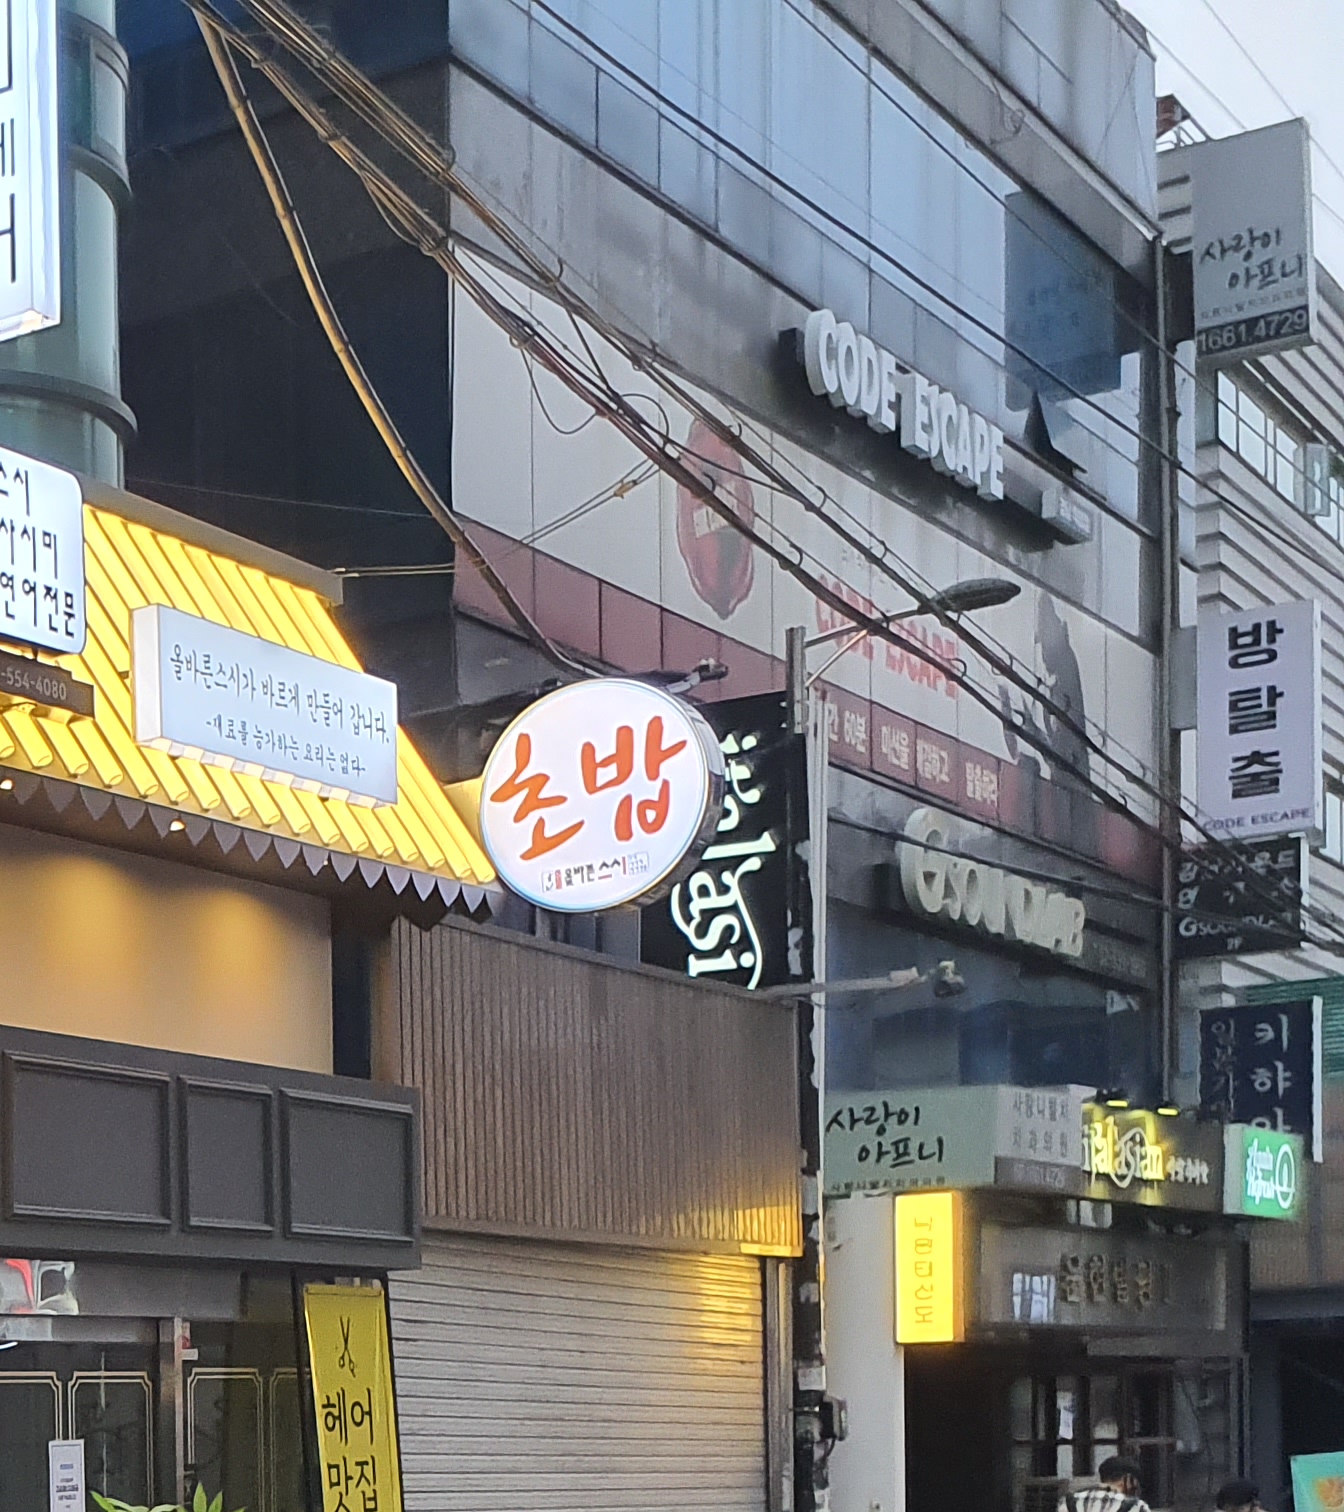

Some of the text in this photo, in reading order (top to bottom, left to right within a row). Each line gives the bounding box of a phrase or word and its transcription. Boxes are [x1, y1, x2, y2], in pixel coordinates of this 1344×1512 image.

[1199, 226, 1281, 265] 사랑이
[1227, 254, 1304, 291] 아프니
[805, 309, 1004, 500] CODE ESCAPE
[0, 571, 76, 638] 연어전문
[170, 644, 256, 701] 올바른스시가
[261, 674, 300, 716] 바르게
[306, 689, 343, 729] 만들어
[1228, 619, 1285, 800] 방탈출
[489, 715, 688, 861] 초밥
[1251, 808, 1311, 825] ESCAPE
[825, 1100, 920, 1136] 사랑이
[858, 1136, 944, 1168] 아프니
[321, 1387, 375, 1447] 헤어
